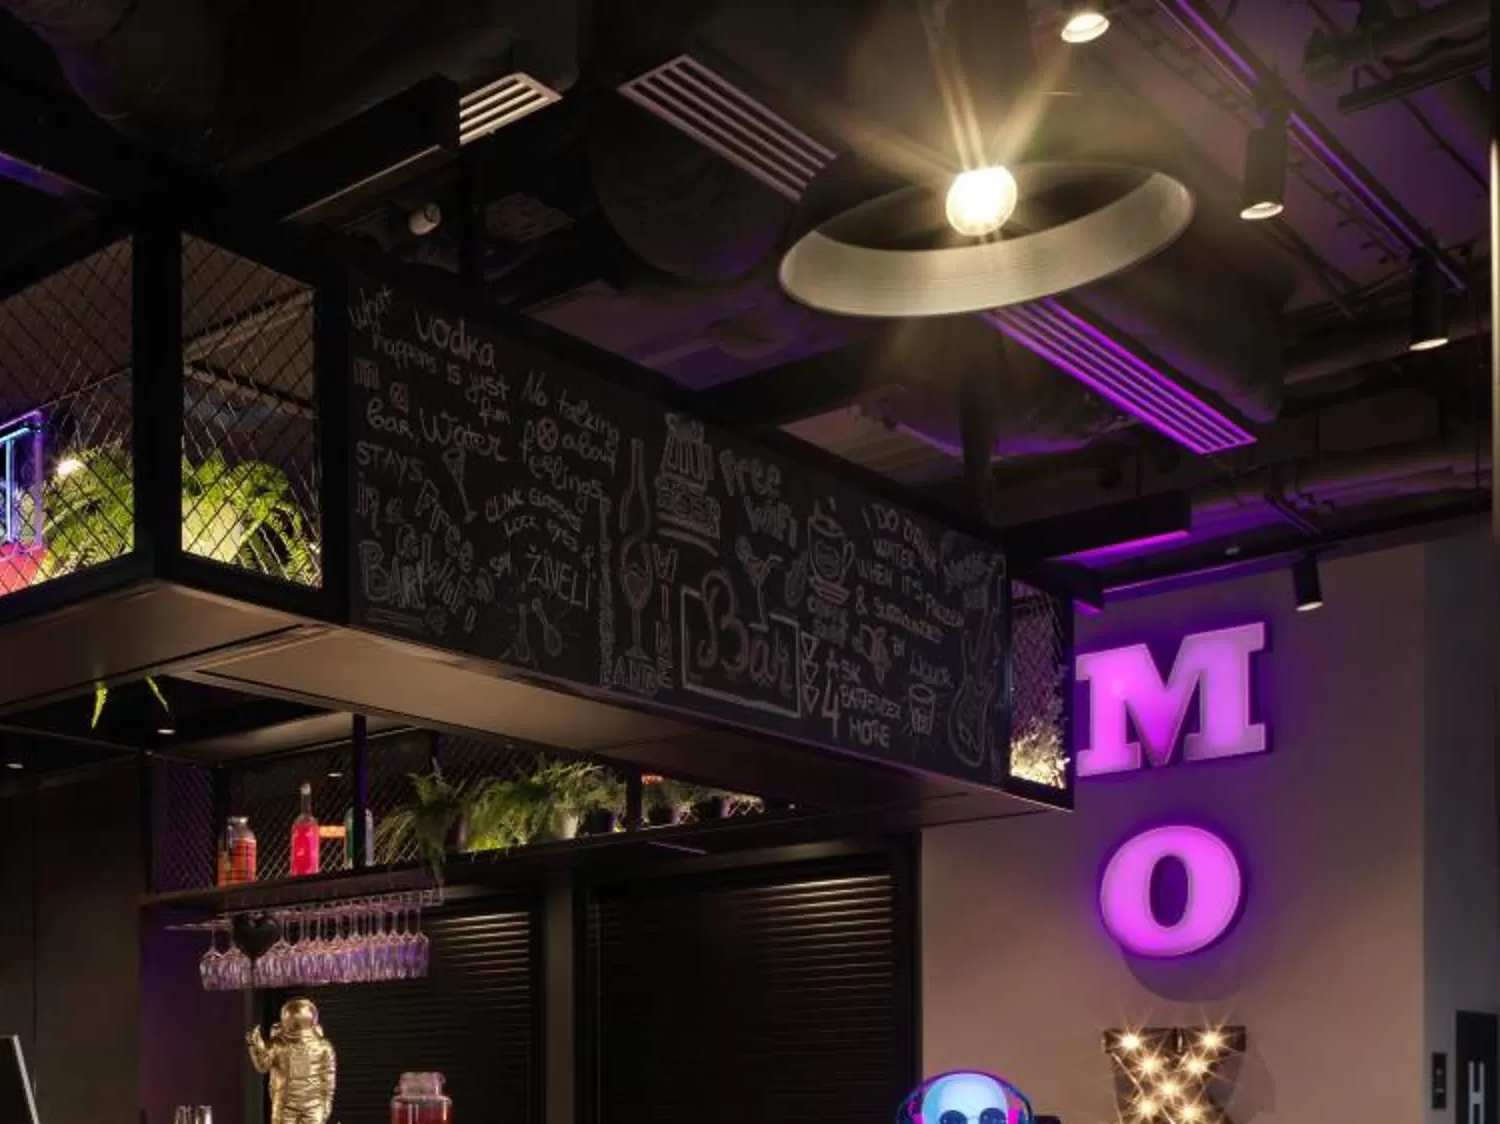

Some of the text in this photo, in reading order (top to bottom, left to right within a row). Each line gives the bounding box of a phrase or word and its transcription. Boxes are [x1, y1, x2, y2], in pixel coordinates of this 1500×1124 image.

[412, 303, 497, 374] Vodka
[356, 440, 425, 487] STAYS
[872, 503, 900, 532] DO
